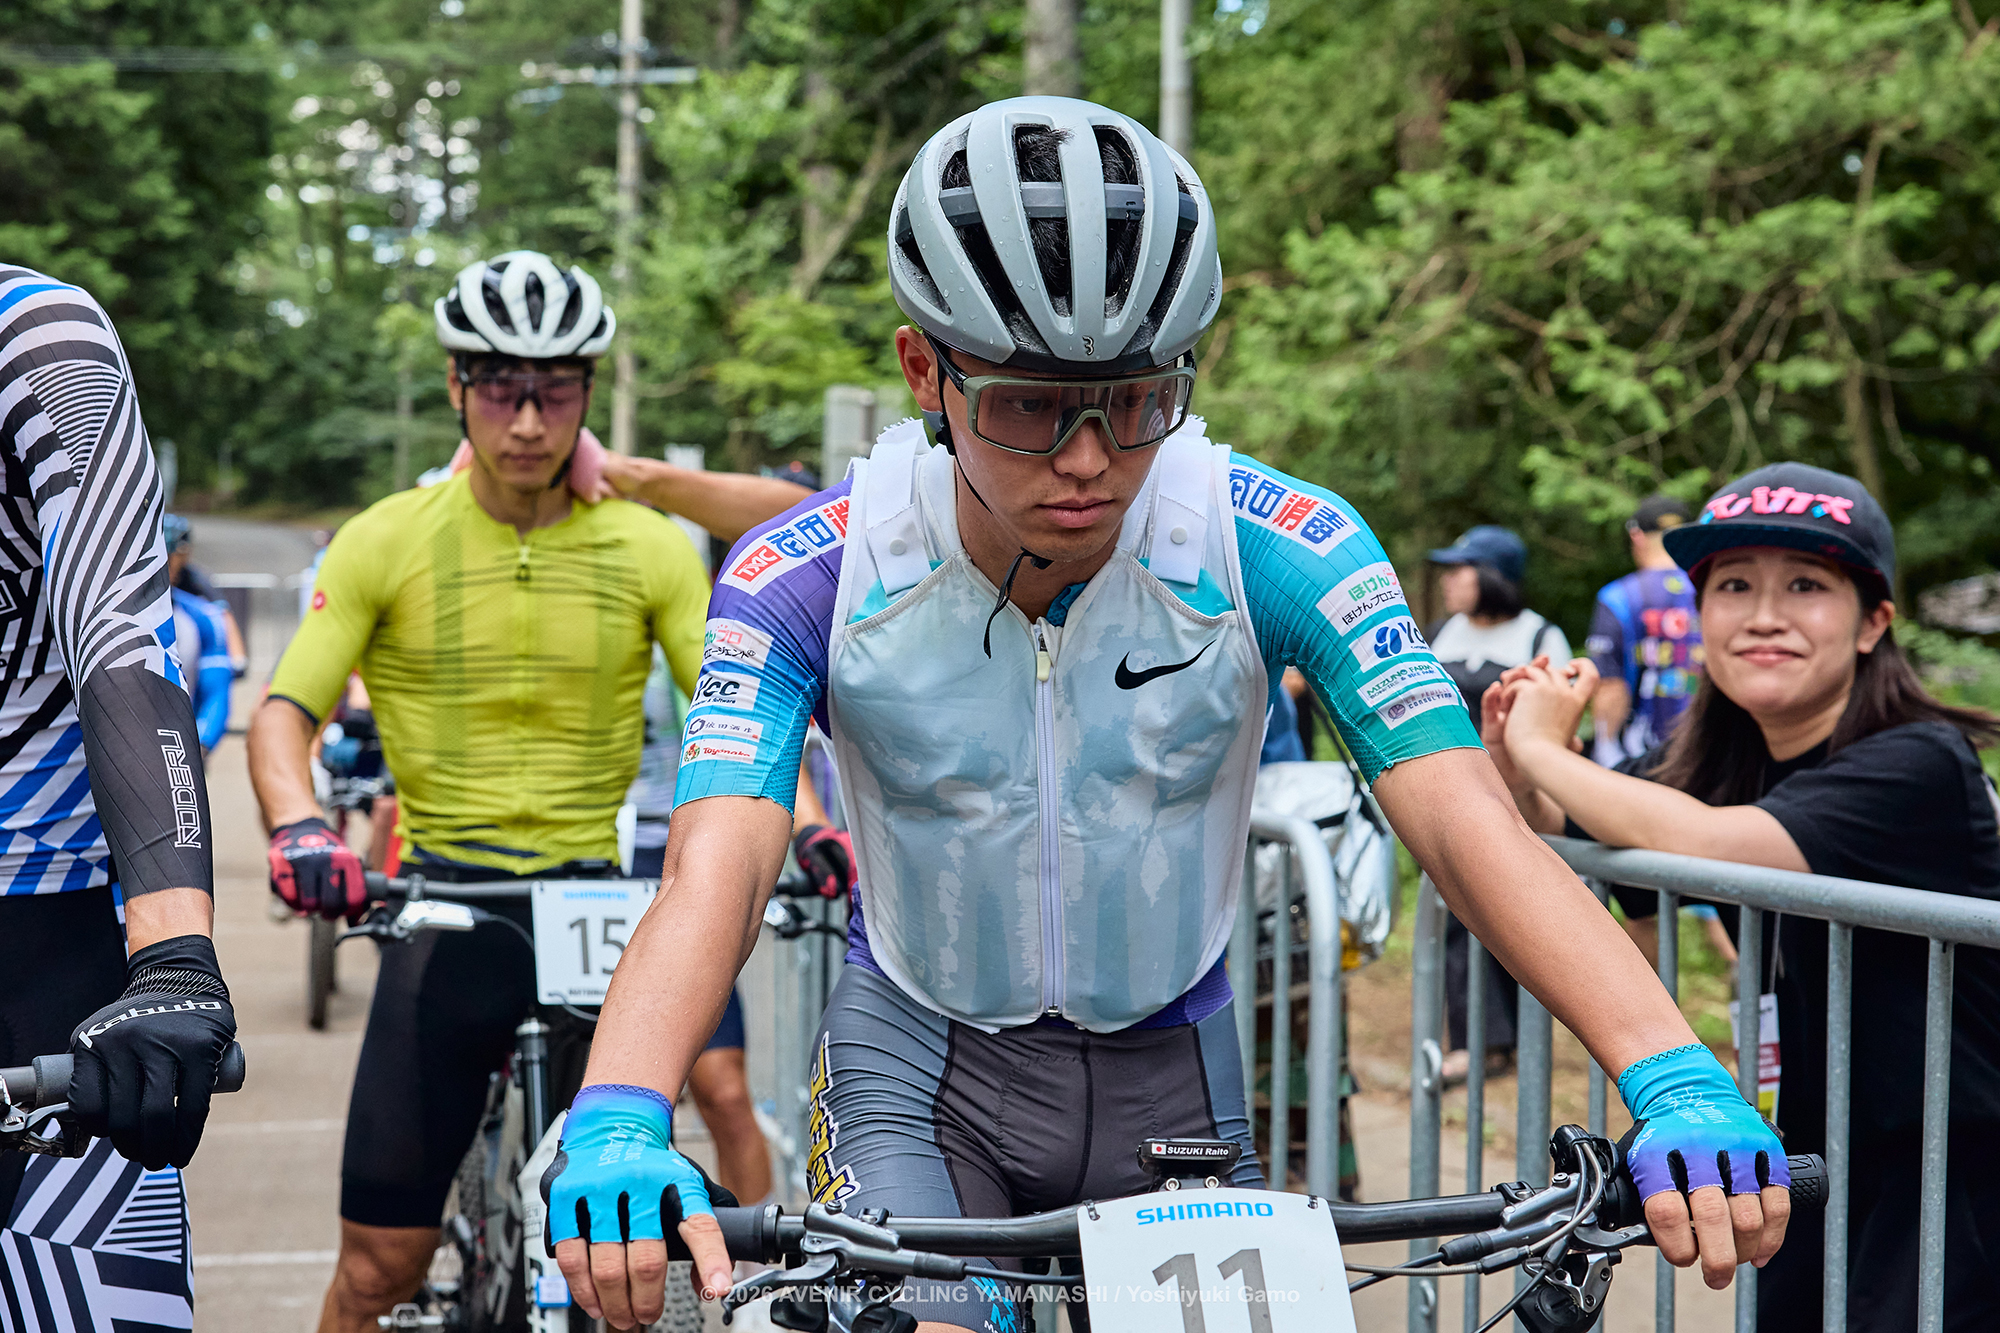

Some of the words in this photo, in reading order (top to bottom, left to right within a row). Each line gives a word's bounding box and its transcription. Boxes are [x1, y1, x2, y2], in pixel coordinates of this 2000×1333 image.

[1367, 669, 1408, 696] MIZUNO
[568, 917, 627, 976] 15
[79, 999, 222, 1049] Kabuto
[1167, 1146, 1203, 1156] SUZUKI
[1205, 1147, 1229, 1156] Raito
[1136, 1202, 1274, 1226] SHIMANO
[1152, 1248, 1274, 1333] 11
